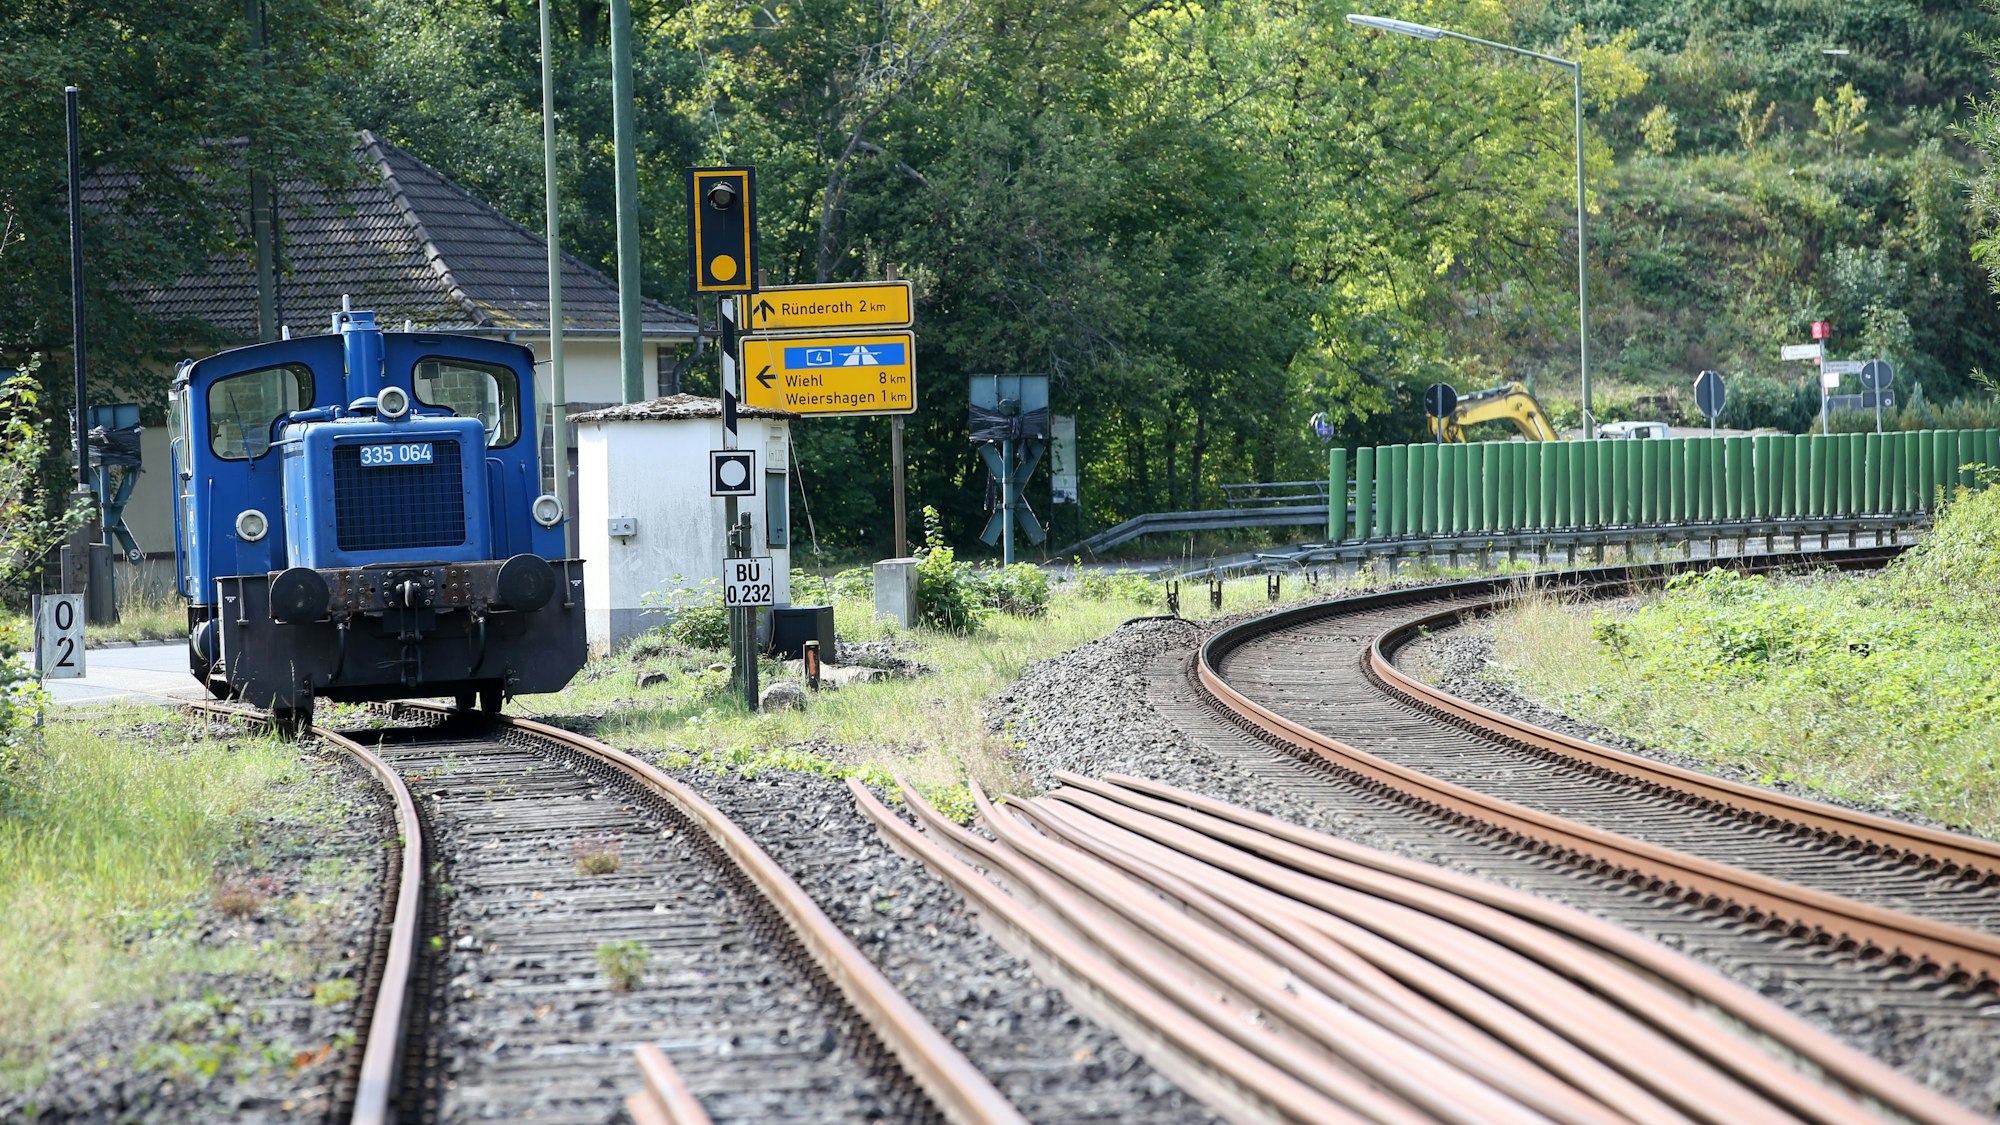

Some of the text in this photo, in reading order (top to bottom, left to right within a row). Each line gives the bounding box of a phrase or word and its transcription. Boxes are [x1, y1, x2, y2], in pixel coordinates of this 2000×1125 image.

[781, 300, 886, 316] Ründeroth 2 km
[816, 352, 823, 363] 4
[785, 372, 906, 387] Wiehl 8 km
[786, 390, 907, 406] Weiershagen 1 km
[361, 444, 431, 464] 335 064
[736, 559, 760, 582] BÜ
[728, 584, 770, 605] 0,232
[55, 600, 74, 630] 0
[56, 637, 74, 666] 2
